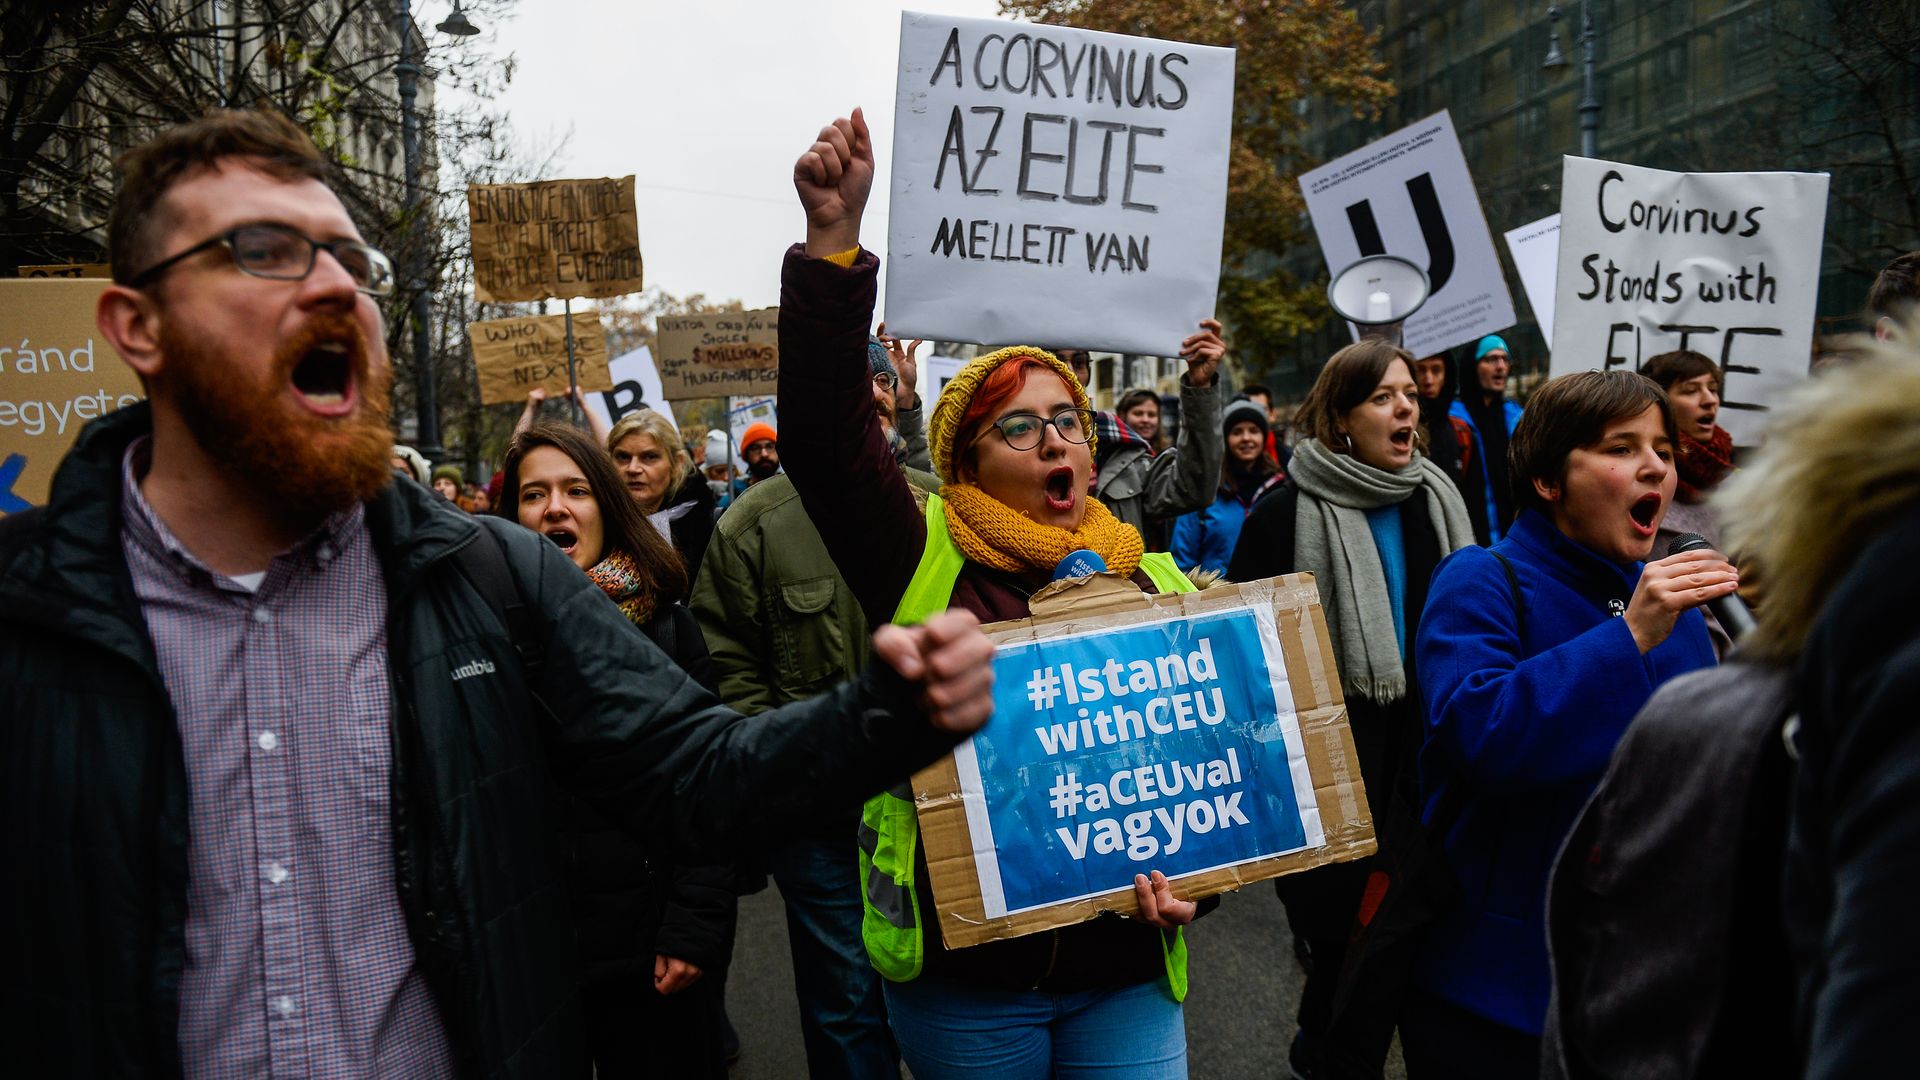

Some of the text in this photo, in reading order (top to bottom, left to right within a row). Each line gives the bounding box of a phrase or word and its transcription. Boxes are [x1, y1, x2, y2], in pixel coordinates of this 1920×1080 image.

[930, 27, 1188, 110] A CORVINUS
[933, 105, 1167, 214] AZ ELTE
[1598, 170, 1764, 238] Corvinus
[930, 217, 1149, 274] MELLETT VAN
[1577, 253, 1776, 304] Stands with
[484, 323, 537, 342] WHO
[662, 320, 706, 331] VIKTOR
[701, 334, 749, 345] STOLEN
[1027, 637, 1219, 711] #Istand
[1035, 687, 1227, 756] withCEU
[1049, 748, 1243, 819] #aCEUval
